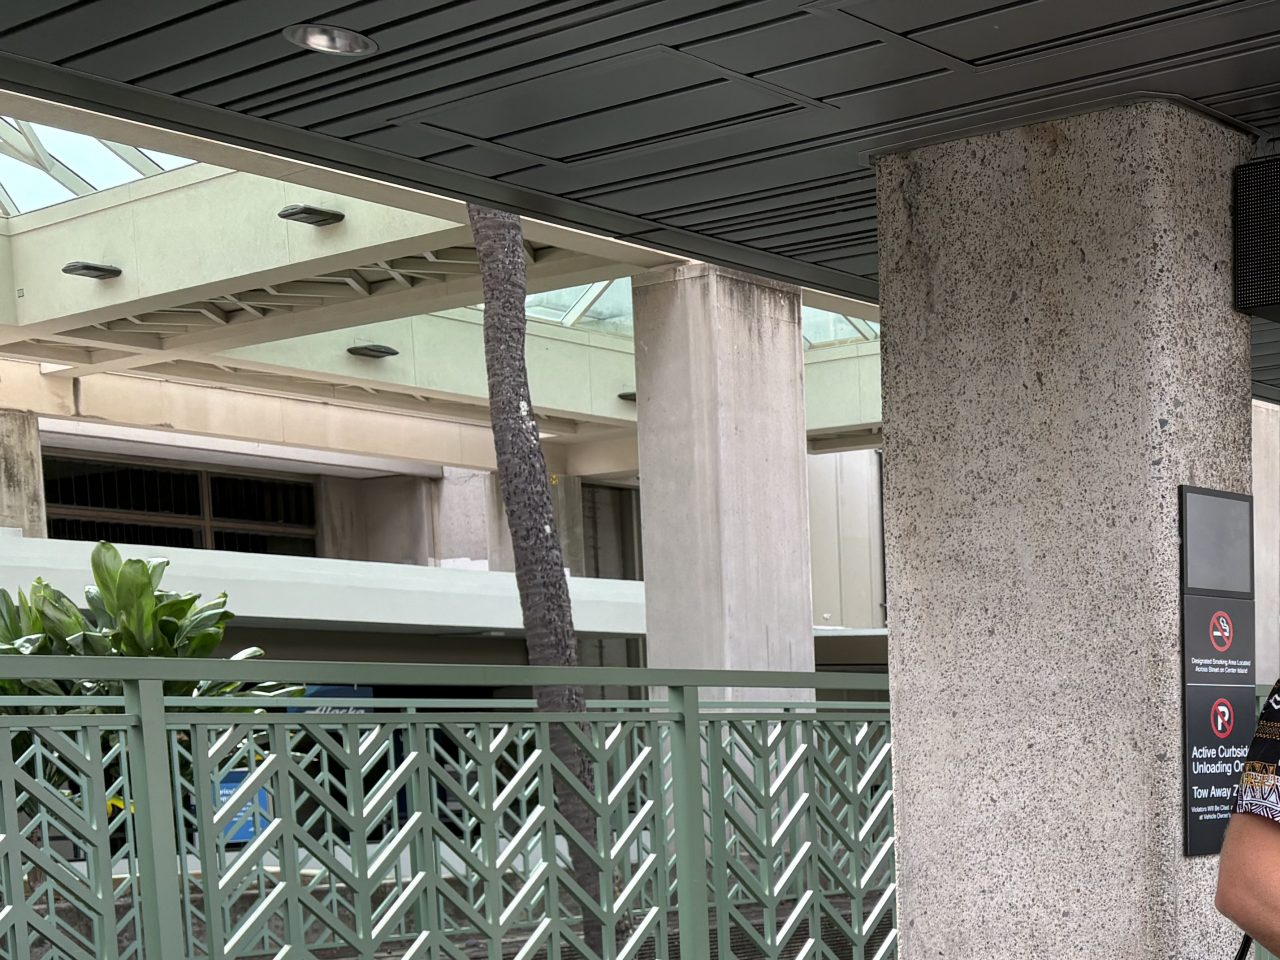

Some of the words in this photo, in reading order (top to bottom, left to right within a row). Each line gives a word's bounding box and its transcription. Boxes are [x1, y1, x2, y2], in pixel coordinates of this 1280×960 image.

[1192, 746, 1216, 758] Active
[1218, 745, 1249, 758] Curbsid
[1192, 760, 1232, 776] Unloading
[1192, 786, 1209, 799] Tow
[1210, 786, 1231, 799] Away
